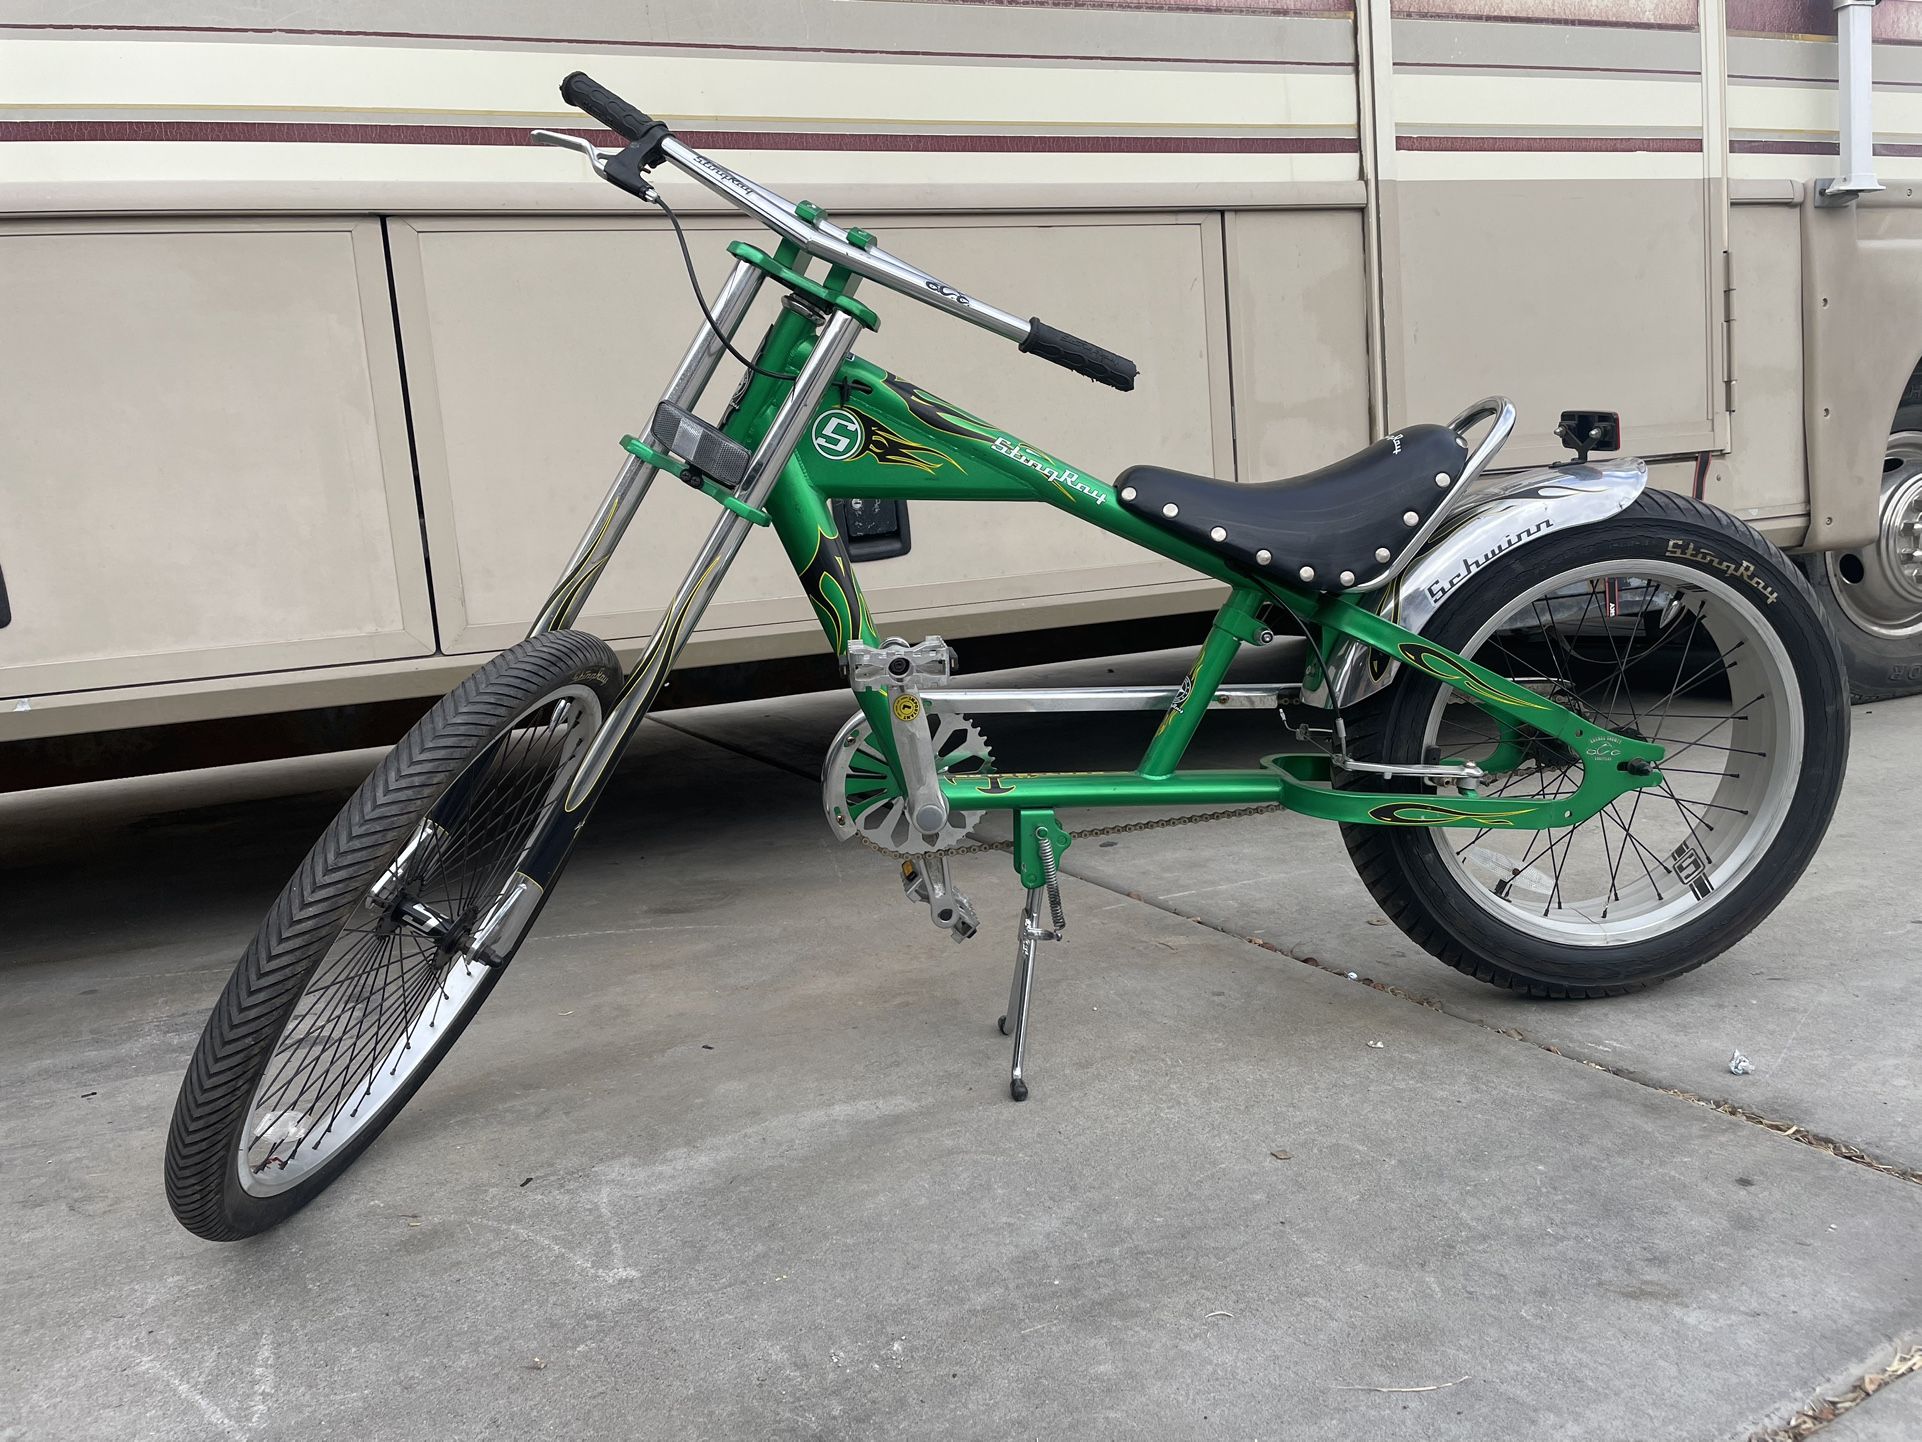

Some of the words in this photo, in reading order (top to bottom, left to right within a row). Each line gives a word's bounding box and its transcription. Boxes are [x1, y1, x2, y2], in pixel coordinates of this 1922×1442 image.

[991, 437, 1107, 505] StingRay
[1427, 519, 1554, 604] Schwinn
[1665, 539, 1779, 605] StingRay
